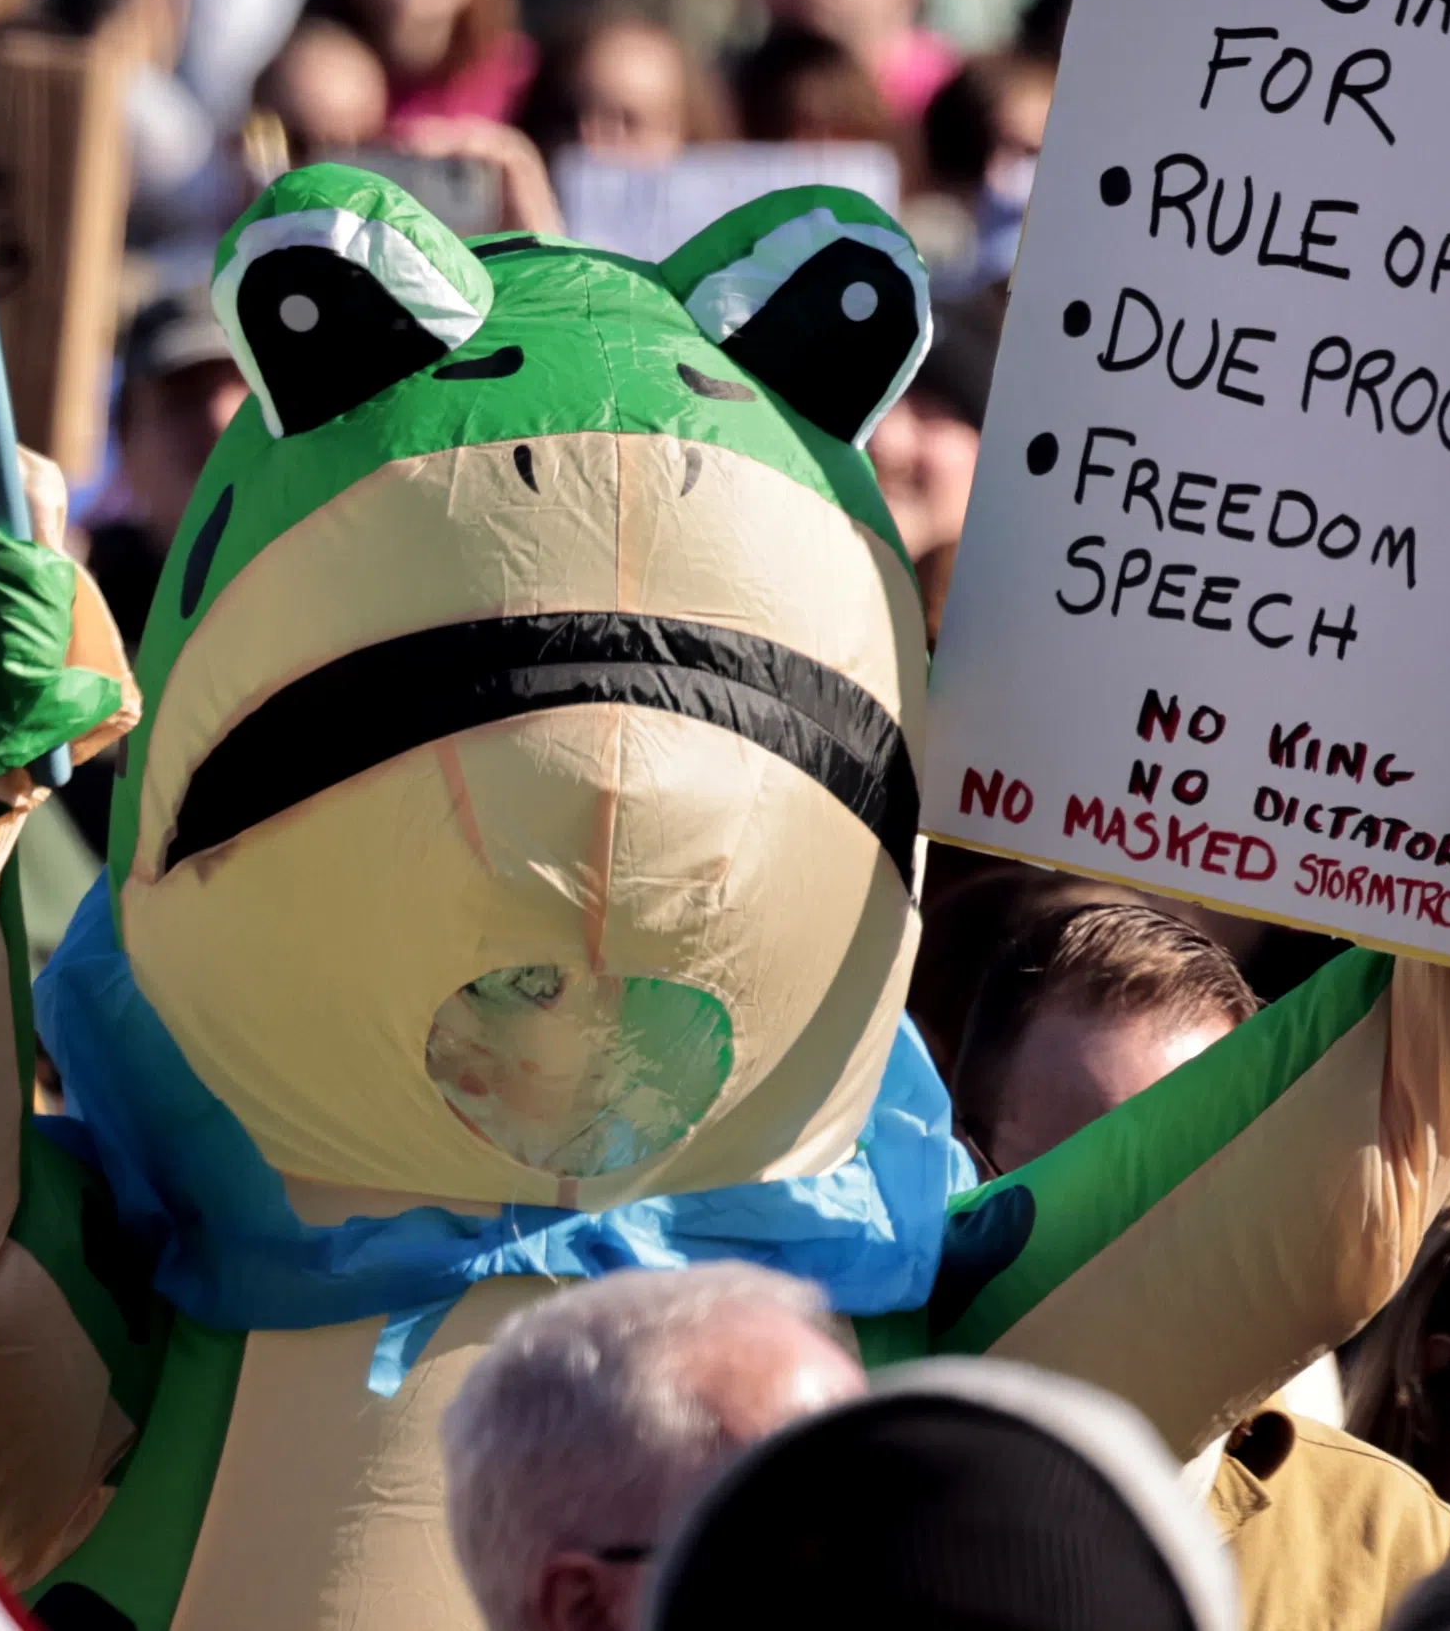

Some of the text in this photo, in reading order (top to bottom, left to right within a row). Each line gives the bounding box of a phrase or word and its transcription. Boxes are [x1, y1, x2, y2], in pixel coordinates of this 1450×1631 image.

[1200, 27, 1395, 146] FOR
[1149, 153, 1359, 280] RULE
[1097, 287, 1276, 406] DUE
[1074, 427, 1416, 589] FREEDOM
[1056, 535, 1357, 660] SPEECH
[1128, 759, 1208, 806] NO
[1137, 689, 1415, 787] NO KING
[959, 767, 1033, 824] NO
[1063, 794, 1277, 881] MASKED
